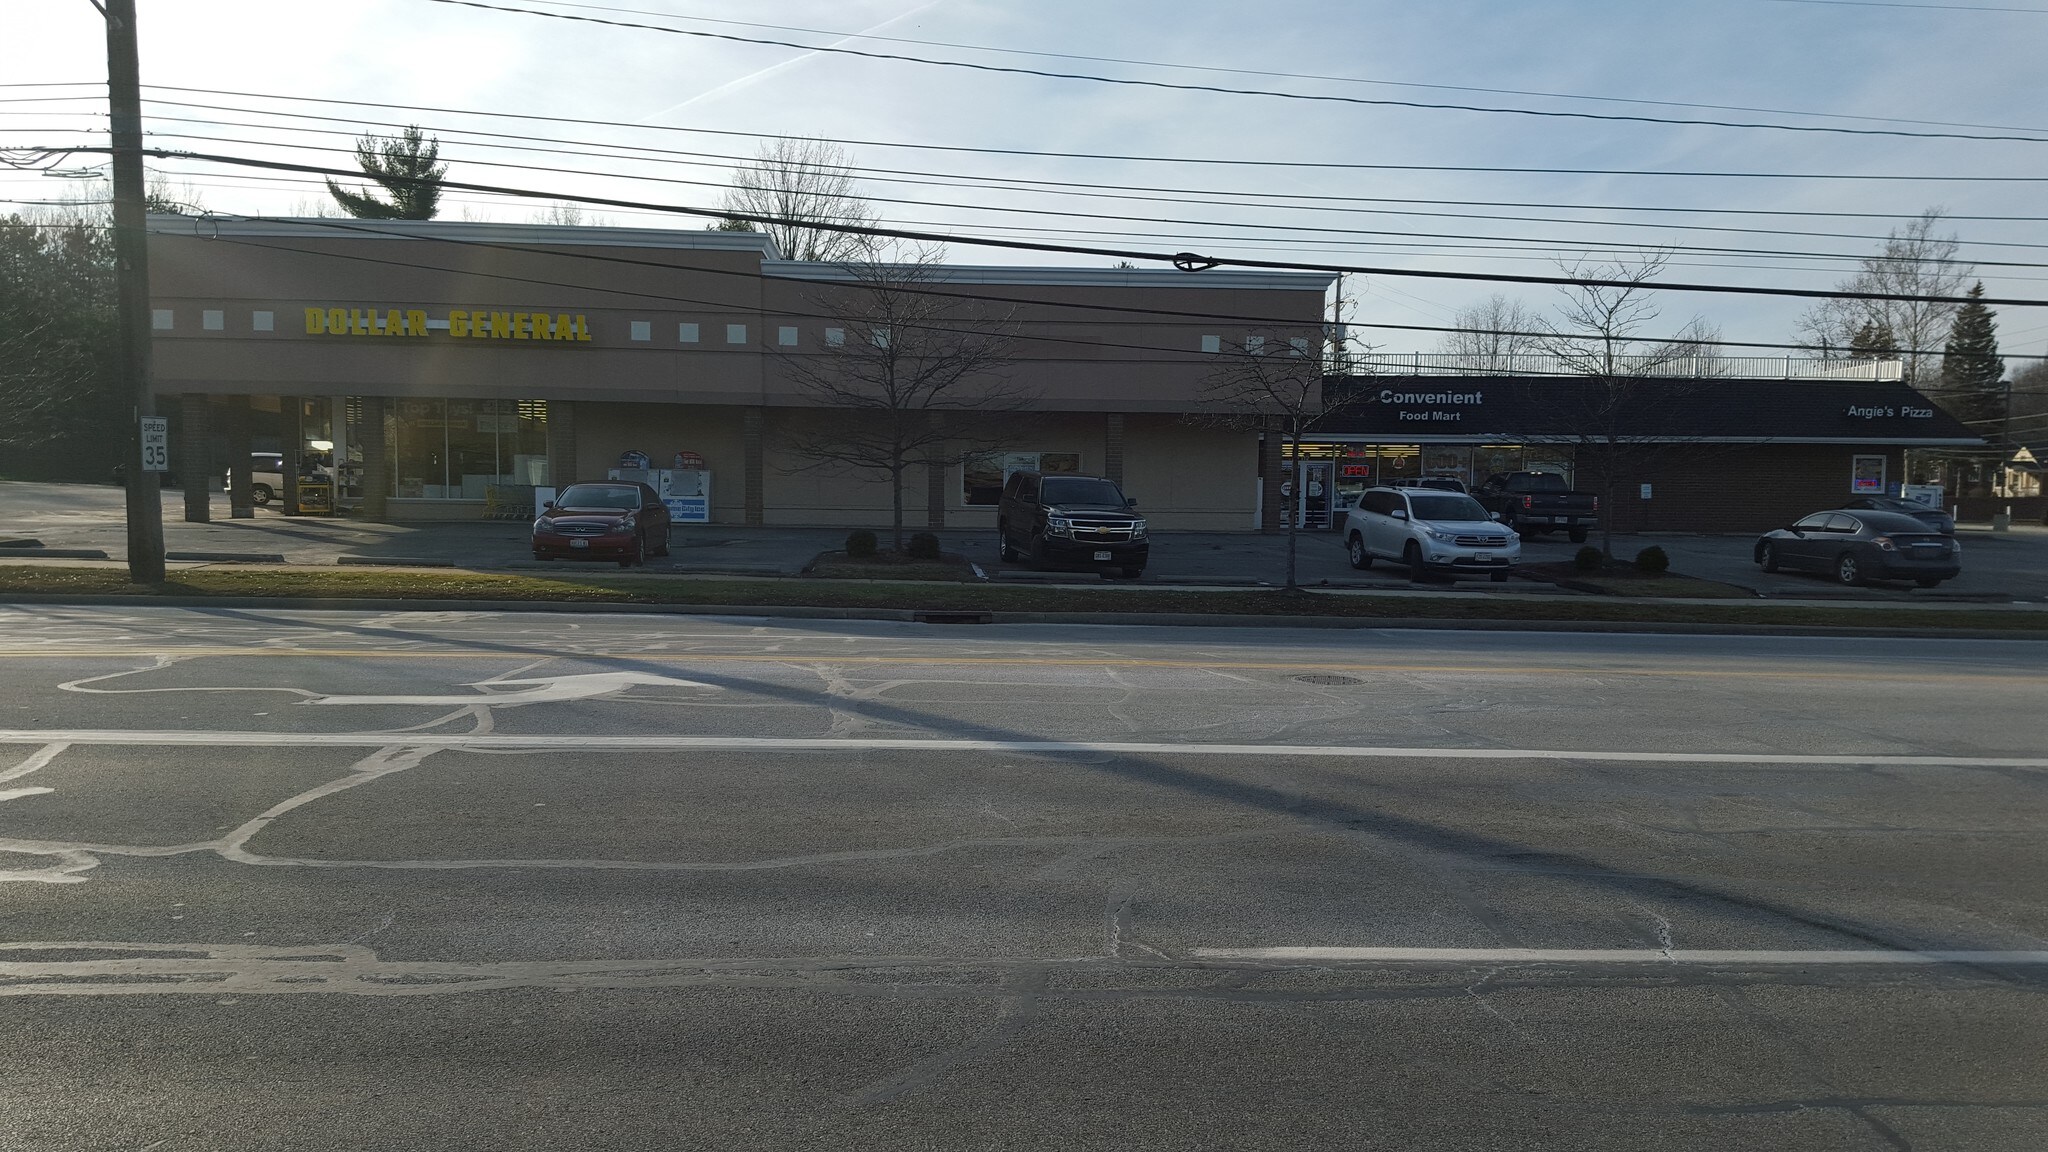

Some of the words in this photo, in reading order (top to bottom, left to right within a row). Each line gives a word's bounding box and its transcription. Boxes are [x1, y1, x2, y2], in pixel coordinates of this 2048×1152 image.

[305, 307, 429, 336] DOLLAR
[449, 310, 592, 341] GENERAL
[1380, 389, 1482, 404] Convenient
[1399, 411, 1429, 421] Food
[1432, 411, 1461, 421] Mart
[1847, 405, 1894, 419] Angie's
[1901, 405, 1933, 418] Pizza
[143, 423, 165, 432] SPEED
[146, 434, 163, 443] LIMIT
[146, 446, 165, 465] 35
[1343, 466, 1369, 476] OPEN
